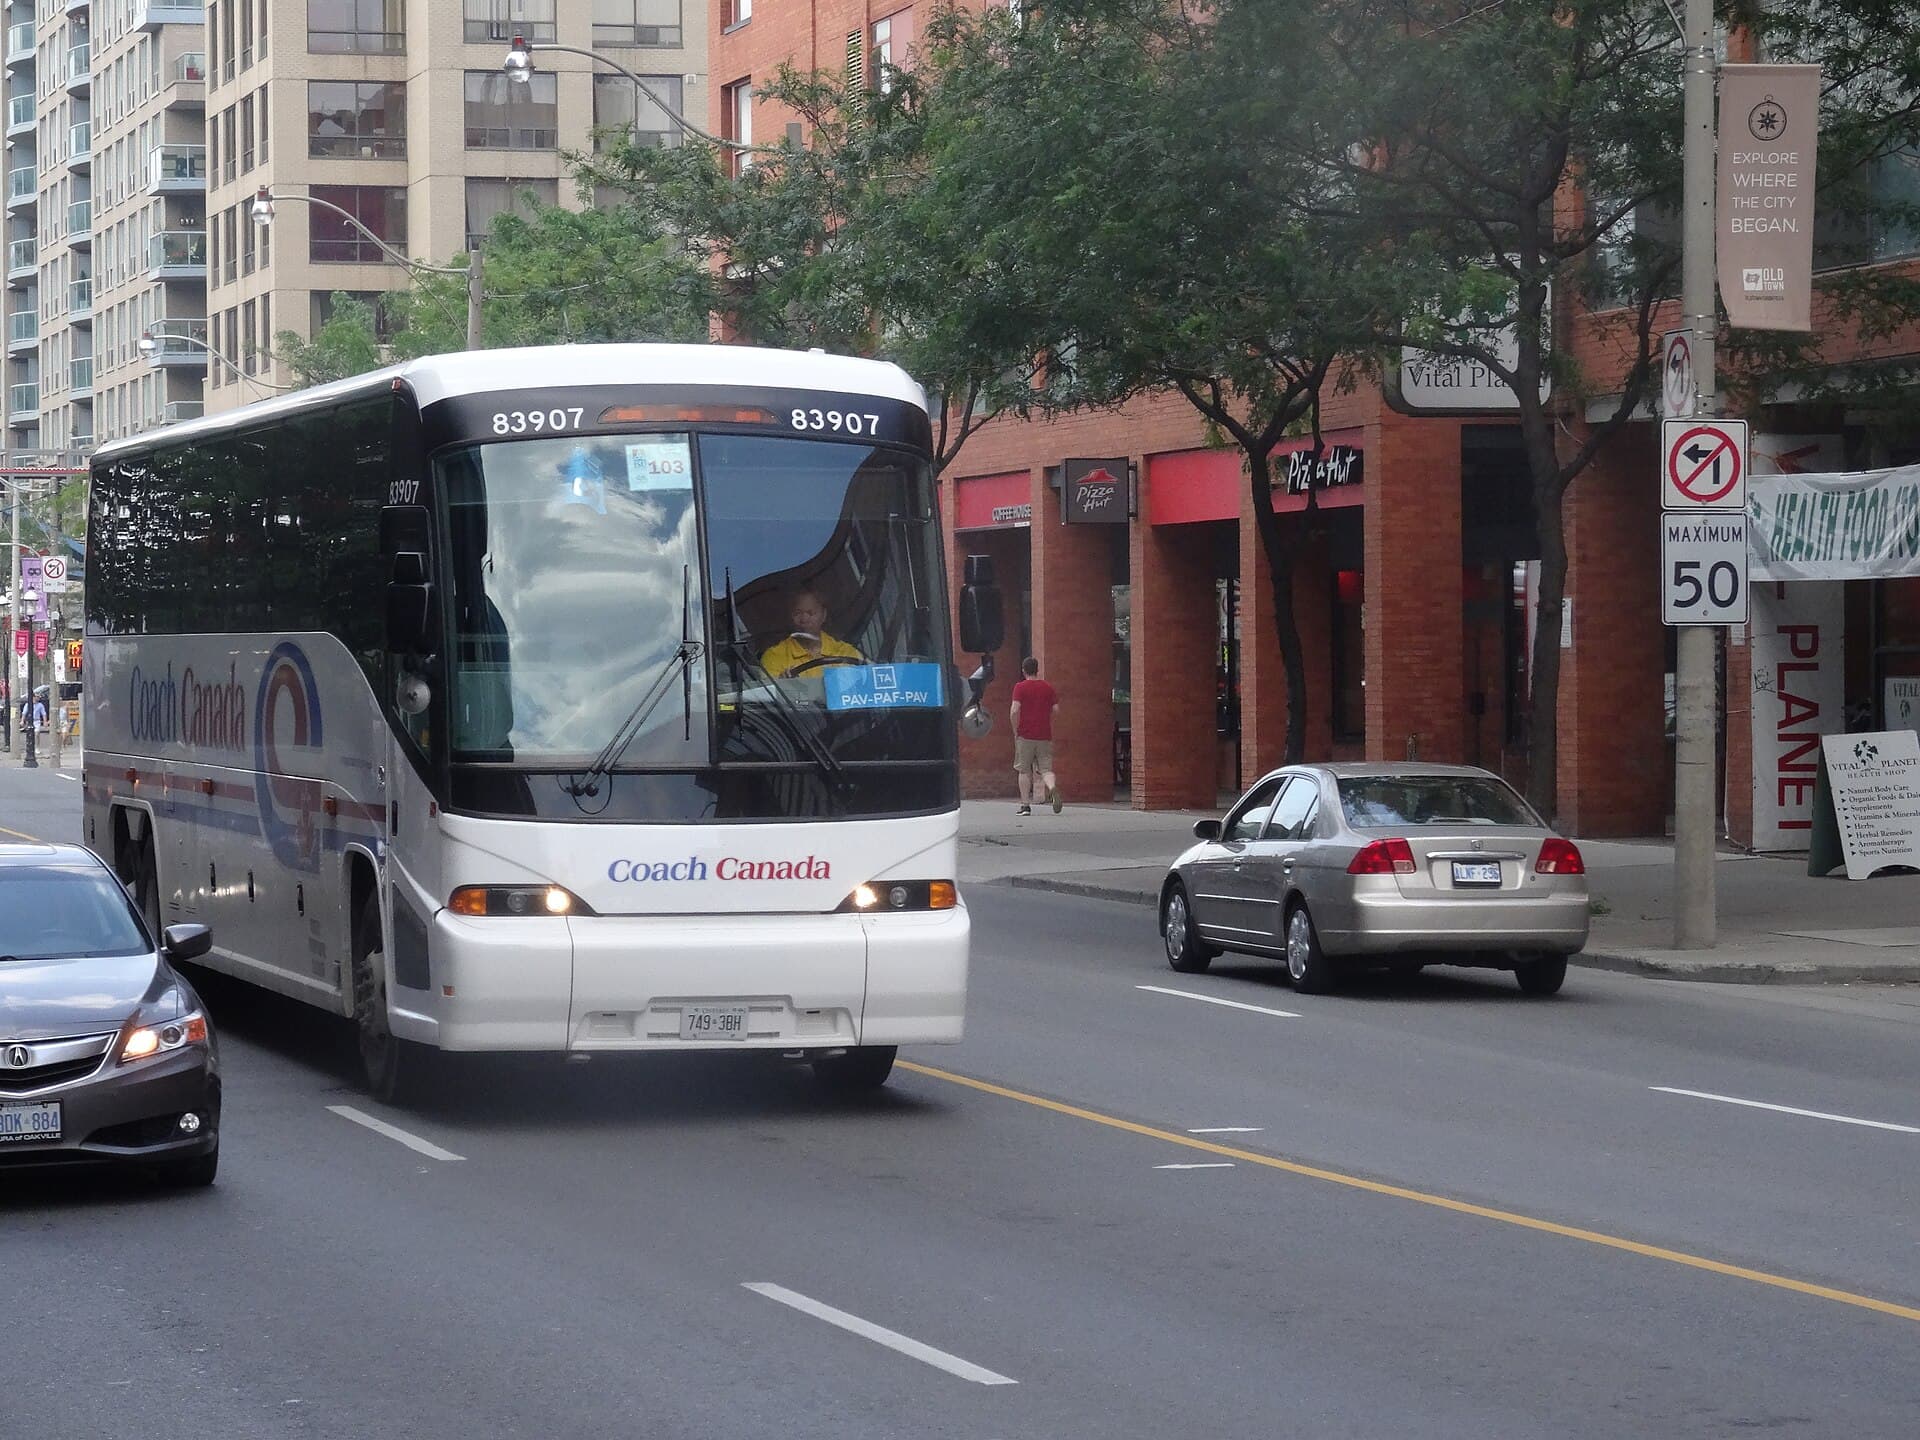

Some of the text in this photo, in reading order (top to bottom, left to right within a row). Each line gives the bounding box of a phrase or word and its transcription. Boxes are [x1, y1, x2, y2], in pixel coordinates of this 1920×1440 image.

[1732, 152, 1799, 164] EXPLORE
[1732, 173, 1798, 188] WHERE
[1732, 196, 1796, 209] THE CITY
[1731, 217, 1799, 233] BEGAN.
[1763, 268, 1784, 281] OLD
[1763, 281, 1785, 291] TOWN
[1407, 365, 1461, 388] Vital
[492, 407, 584, 435] 83907
[791, 408, 880, 435] 83907
[648, 459, 684, 475] 103
[1287, 447, 1357, 495] Piza Hut
[389, 479, 420, 505] 83907
[1075, 485, 1115, 503] Pizza
[1082, 498, 1113, 513] Hut
[1770, 490, 1840, 562] HEALTH
[1840, 487, 1889, 562] FOOD
[1668, 526, 1742, 543] MAXIMUM
[1673, 560, 1740, 608] 50
[877, 673, 893, 683] TA
[130, 659, 246, 752] Coach Canada
[841, 691, 928, 706] PAV-PAF-PAV
[1832, 758, 1918, 772] VITAL PLANET
[1847, 771, 1881, 779] HEALTH
[1847, 784, 1910, 795] Natural Body Care
[1848, 795, 1876, 803] Organic
[1877, 793, 1897, 801] Foods
[1850, 803, 1893, 812] Supplements
[1854, 822, 1875, 830] Herbs
[1856, 828, 1913, 839] Herbal Remedies
[1858, 839, 1906, 848] Aromatherapy
[1858, 846, 1913, 857] Sports Nutrition
[607, 854, 831, 883] Coach Canada
[24, 1132, 62, 1140] OAKVILLE
